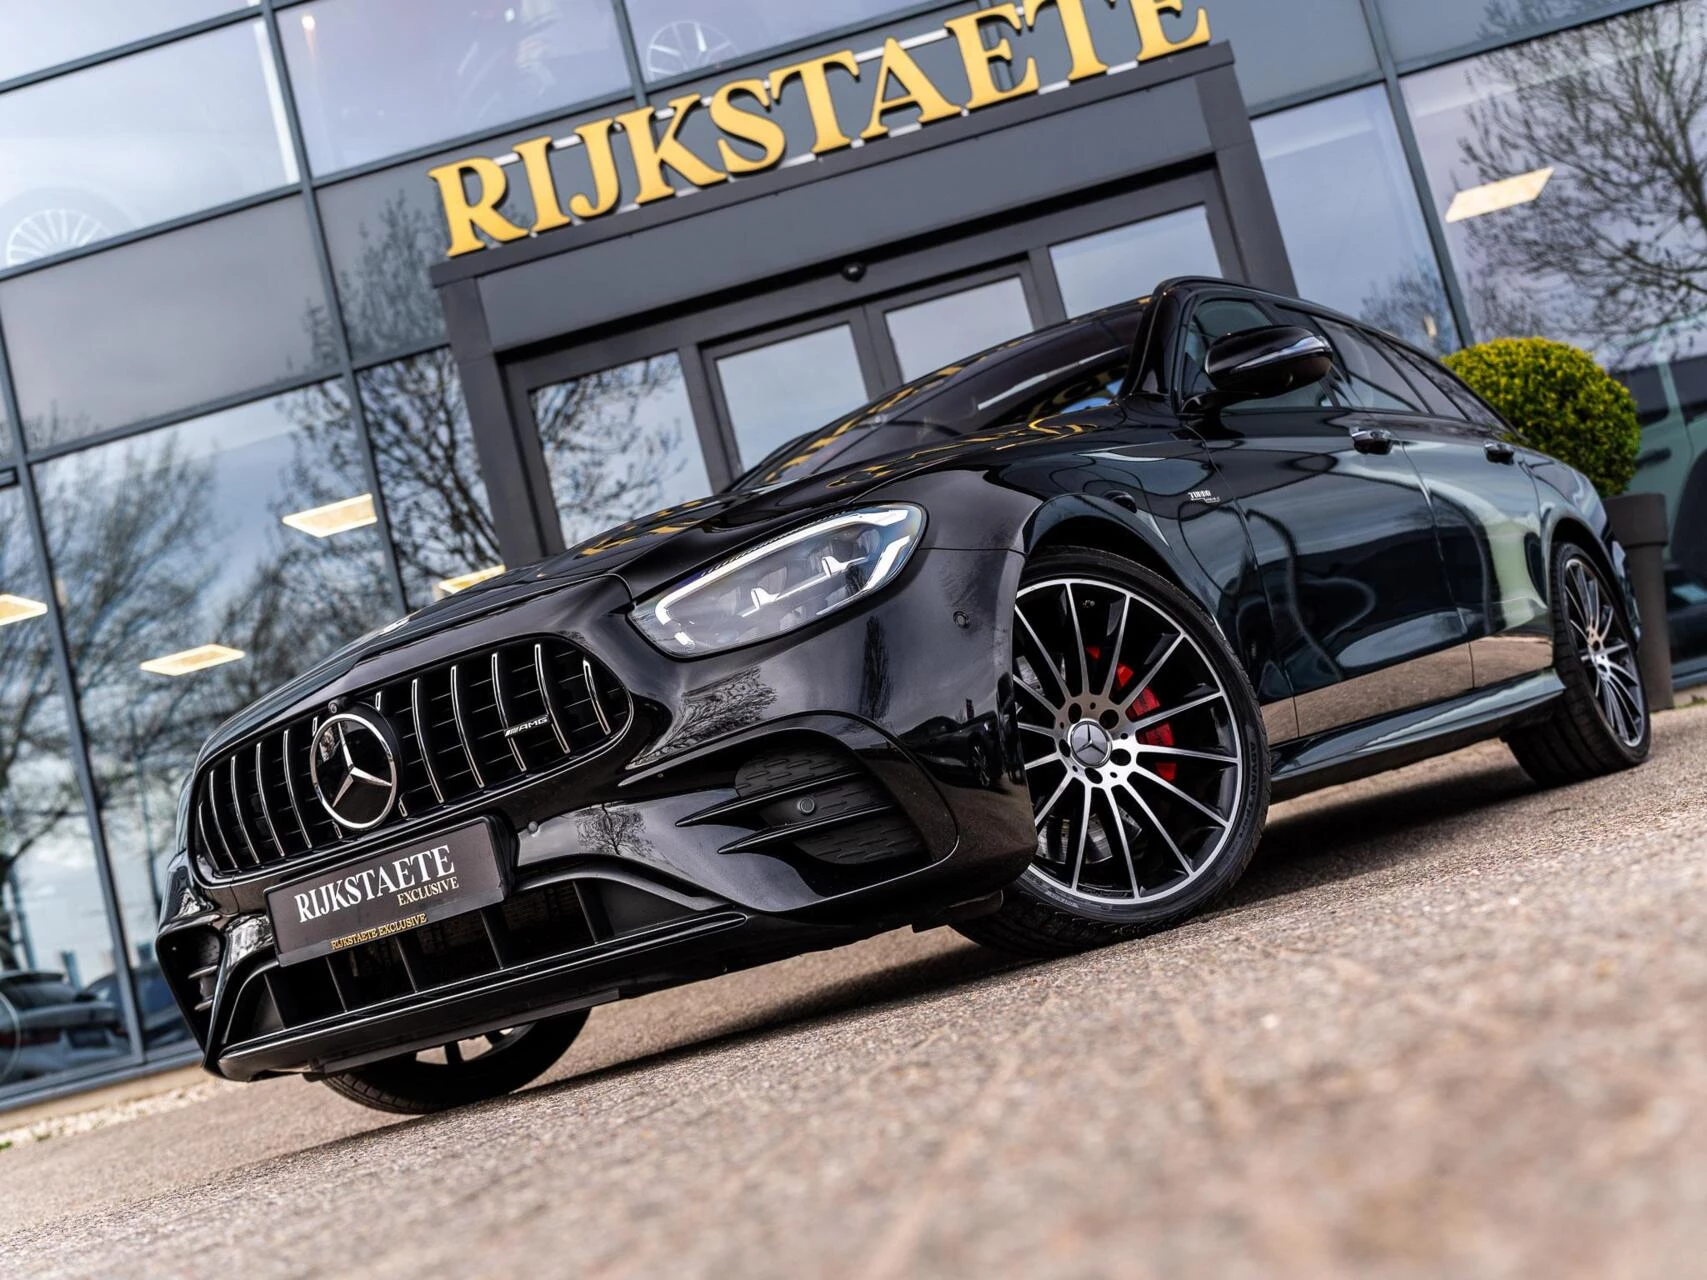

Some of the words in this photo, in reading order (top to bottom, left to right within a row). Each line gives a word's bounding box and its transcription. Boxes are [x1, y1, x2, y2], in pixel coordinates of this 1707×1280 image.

[428, 0, 1212, 258] RIJKSTAETE
[519, 717, 548, 732] AMG
[1250, 741, 1258, 796] ADVAN
[294, 844, 455, 923] RIJKSTAETE
[397, 876, 460, 906] EXCLUSIVE
[331, 928, 378, 950] RIJKSTAETE
[378, 913, 427, 936] EXCLUSIVE
